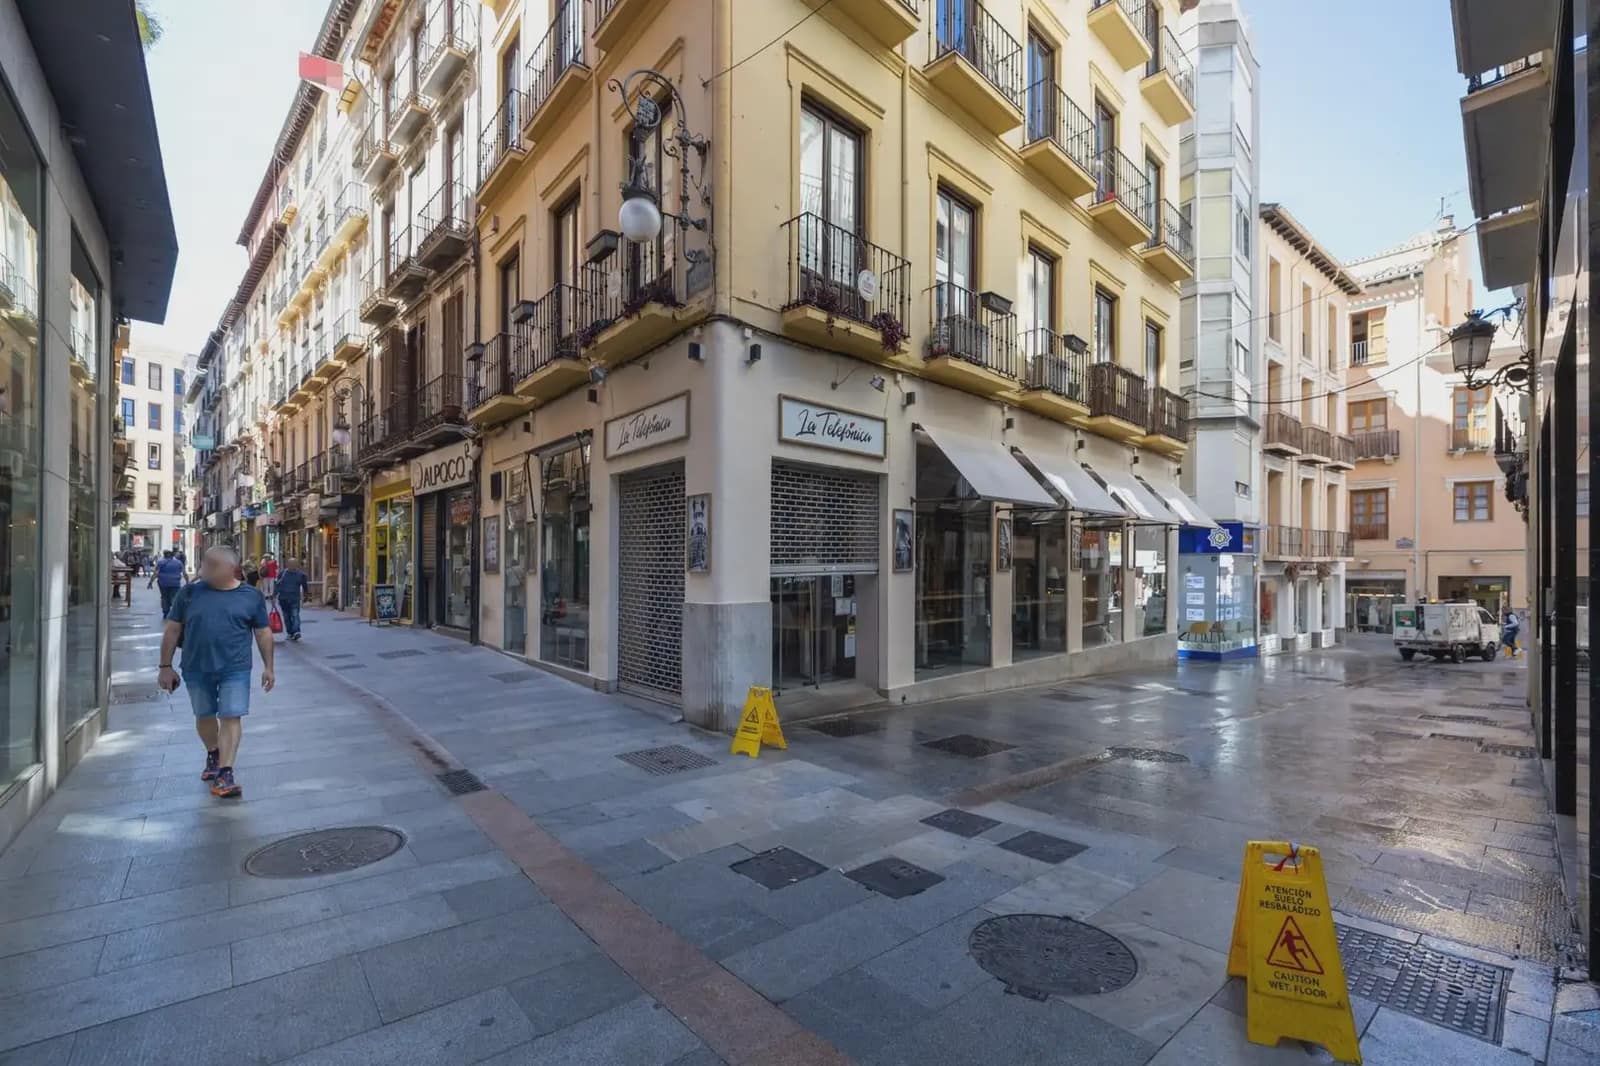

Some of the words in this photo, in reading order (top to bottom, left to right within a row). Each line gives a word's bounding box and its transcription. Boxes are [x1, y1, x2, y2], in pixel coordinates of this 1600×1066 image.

[796, 408, 816, 436] La
[616, 422, 630, 451] La
[1259, 900, 1321, 917] RESBALADIZO
[1274, 894, 1304, 906] SUELO
[1273, 970, 1320, 987] CAUTION
[1294, 984, 1328, 999] FLOOR
